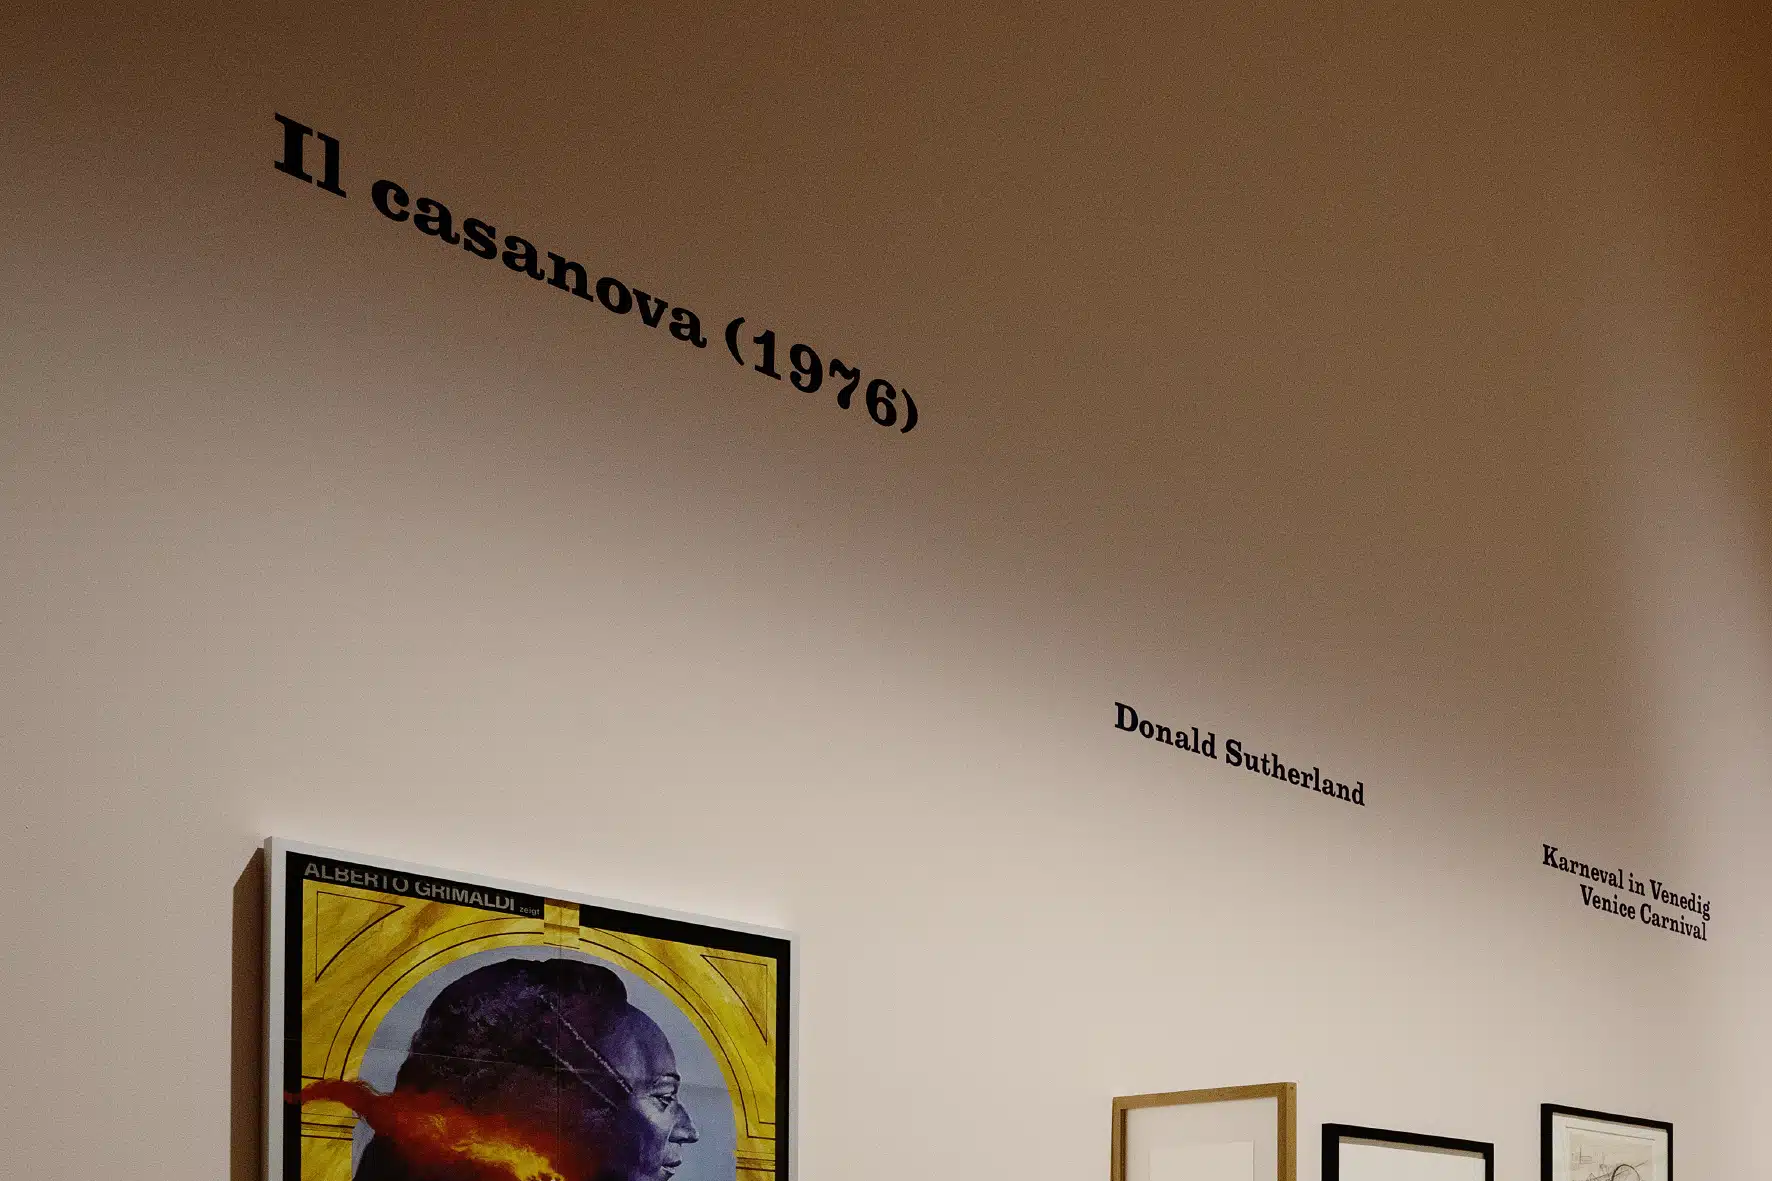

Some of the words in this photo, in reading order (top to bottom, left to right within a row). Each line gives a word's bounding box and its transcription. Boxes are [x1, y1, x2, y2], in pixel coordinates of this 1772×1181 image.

[273, 112, 347, 198] Il
[370, 179, 707, 348] casanova
[724, 316, 918, 434] (1976)
[1114, 701, 1218, 760] Donald
[1224, 739, 1366, 807] Sutherland
[414, 878, 515, 911] GRIMALDI
[519, 905, 540, 916] zeigt
[1541, 843, 1625, 890] Karneval
[1628, 872, 1646, 896] in
[1649, 878, 1712, 921] Venedig
[1580, 884, 1637, 921] Venice
[1639, 903, 1708, 942] Carnival
